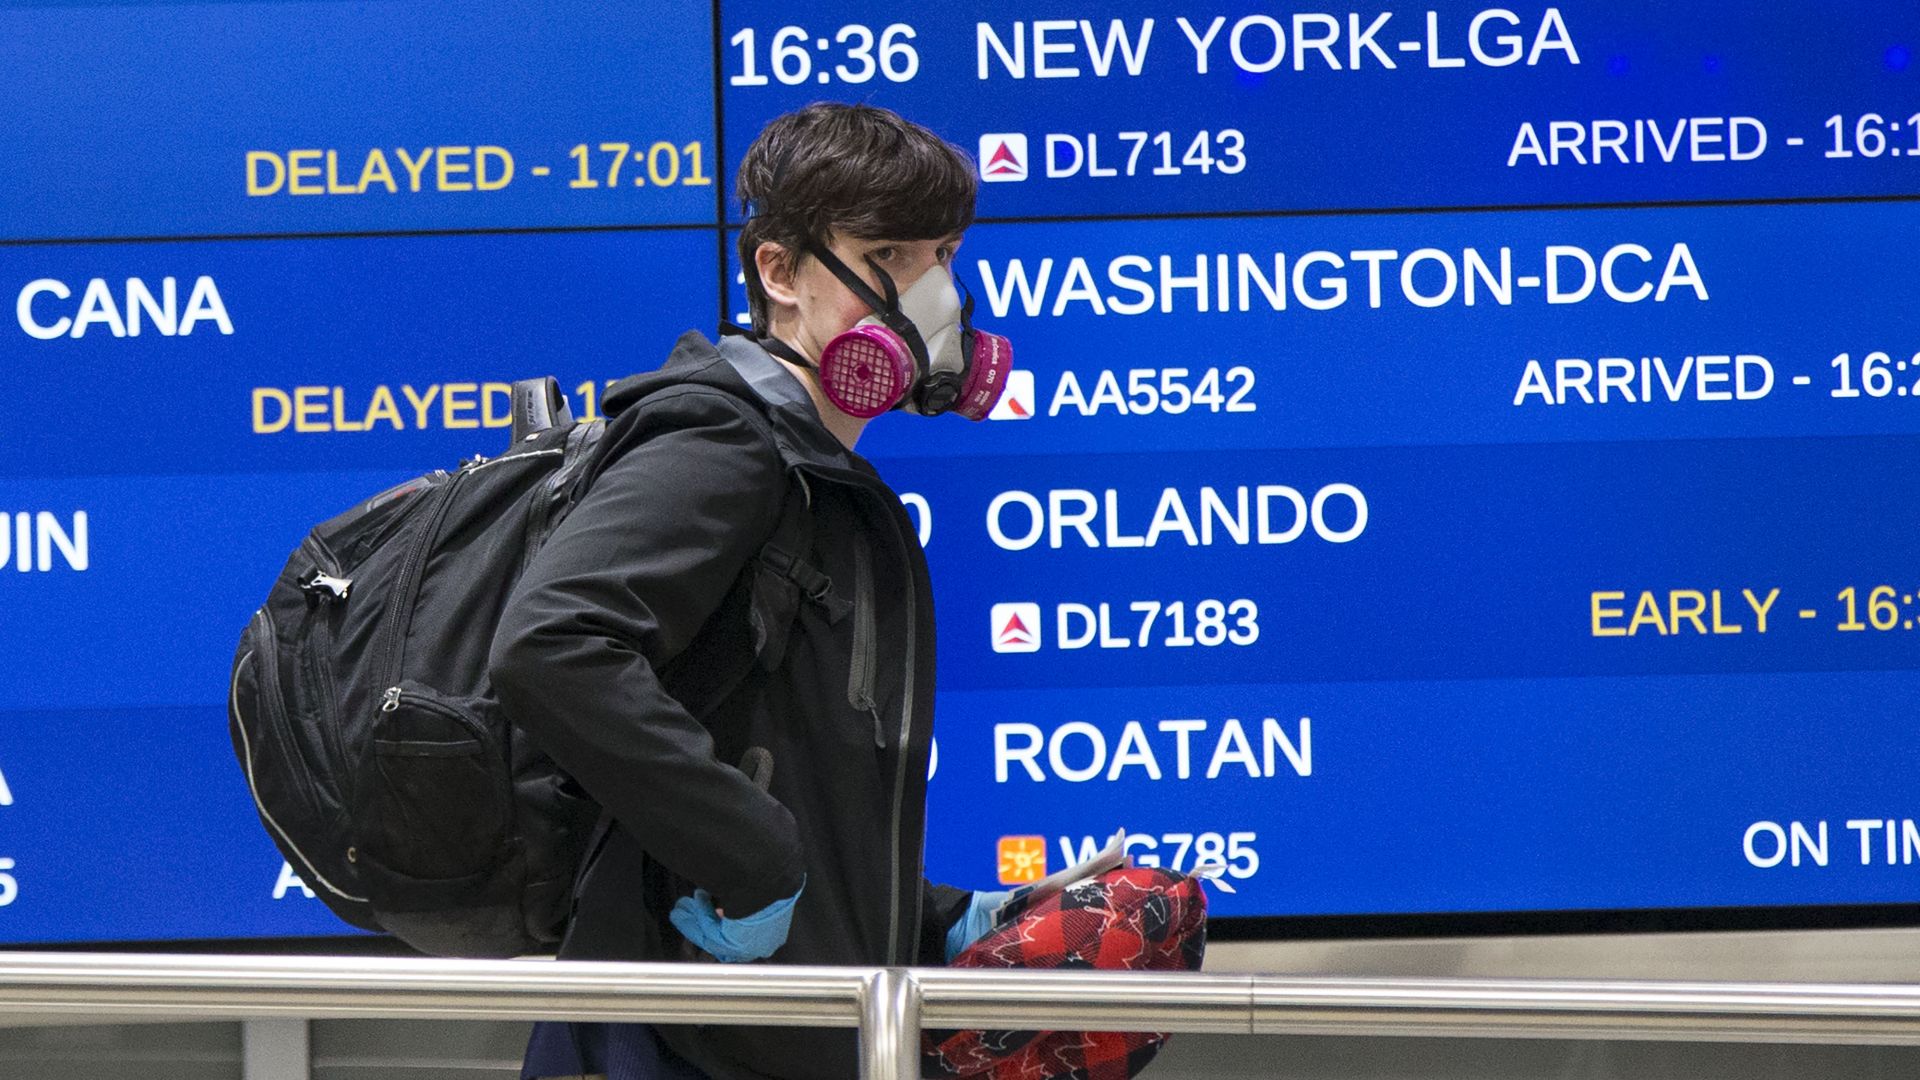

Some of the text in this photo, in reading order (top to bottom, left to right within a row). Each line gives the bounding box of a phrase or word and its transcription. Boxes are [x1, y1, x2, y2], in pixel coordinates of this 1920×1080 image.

[730, 23, 919, 86] 16:36
[976, 7, 1581, 81] NEW YORK-LGA
[245, 146, 514, 197] DELAYED
[569, 141, 712, 189] 17:01
[1045, 128, 1246, 178] DL7143
[1507, 117, 1767, 168] ARRIVED
[16, 275, 234, 340] CANA
[977, 242, 1709, 318] WASHINGTON-DCA
[1049, 366, 1257, 421] AA5542
[1513, 354, 1775, 406] ARRIVED
[252, 382, 512, 435] DELAYED
[0, 510, 89, 573] IN
[986, 483, 1369, 551] ORLANDO
[1057, 598, 1260, 650] DL7183
[1591, 588, 1780, 637] EARLY
[1837, 585, 1920, 632] 16:
[994, 717, 1312, 783] ROATAN
[1058, 831, 1260, 880] WG785
[1742, 820, 1828, 868] ON
